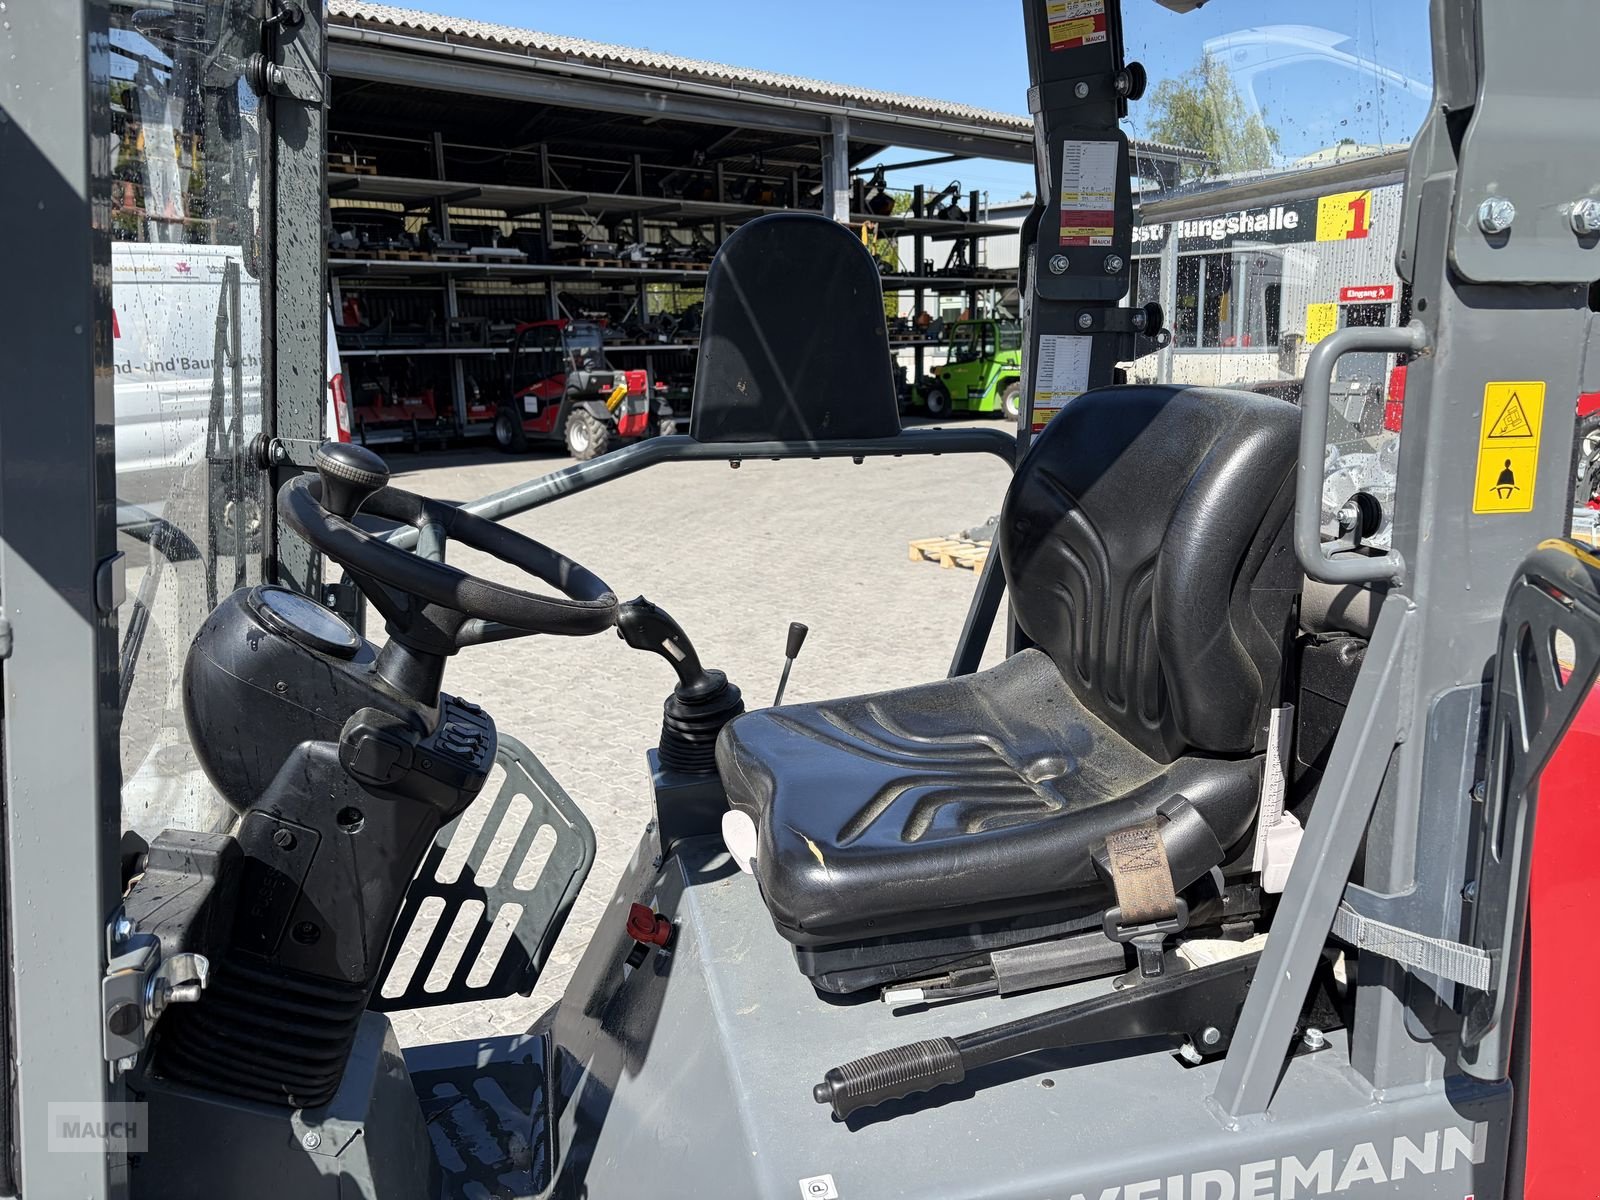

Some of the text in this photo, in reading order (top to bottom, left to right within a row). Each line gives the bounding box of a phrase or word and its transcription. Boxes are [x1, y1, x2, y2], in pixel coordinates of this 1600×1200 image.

[1085, 34, 1105, 42] MAUCH
[1346, 198, 1369, 240] 1
[1346, 289, 1377, 299] Eingang
[1066, 1120, 1488, 1200] IDEMANN
